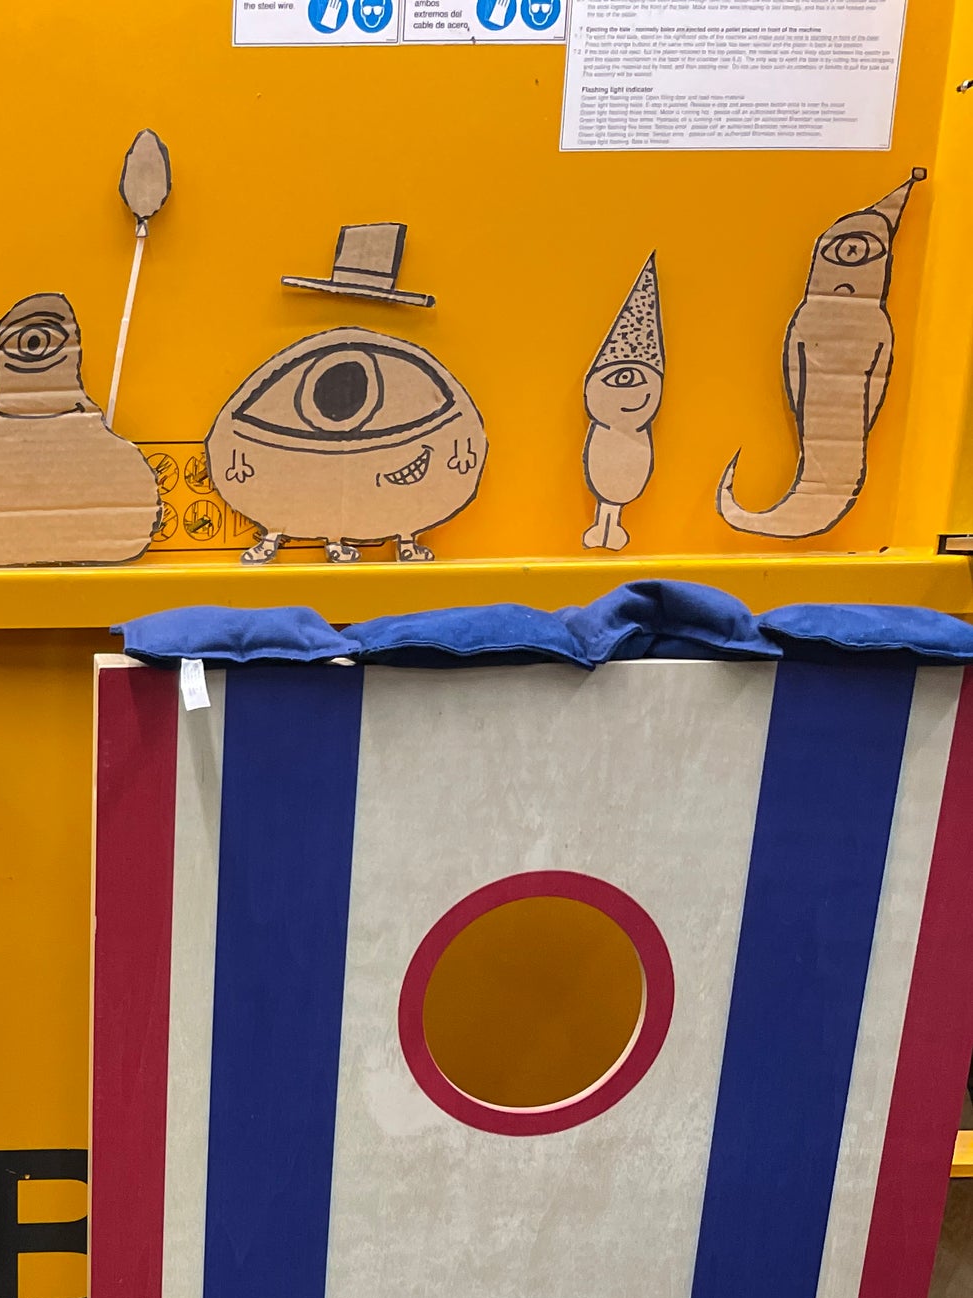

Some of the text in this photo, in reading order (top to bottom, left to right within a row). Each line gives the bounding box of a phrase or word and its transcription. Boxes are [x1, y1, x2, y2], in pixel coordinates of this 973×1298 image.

[244, 2, 256, 10] the
[258, 2, 276, 10] steel
[414, 10, 448, 18] extremos
[413, 21, 434, 29] cable
[435, 21, 445, 29] de
[582, 86, 609, 94] Flashing
[610, 86, 624, 94] light
